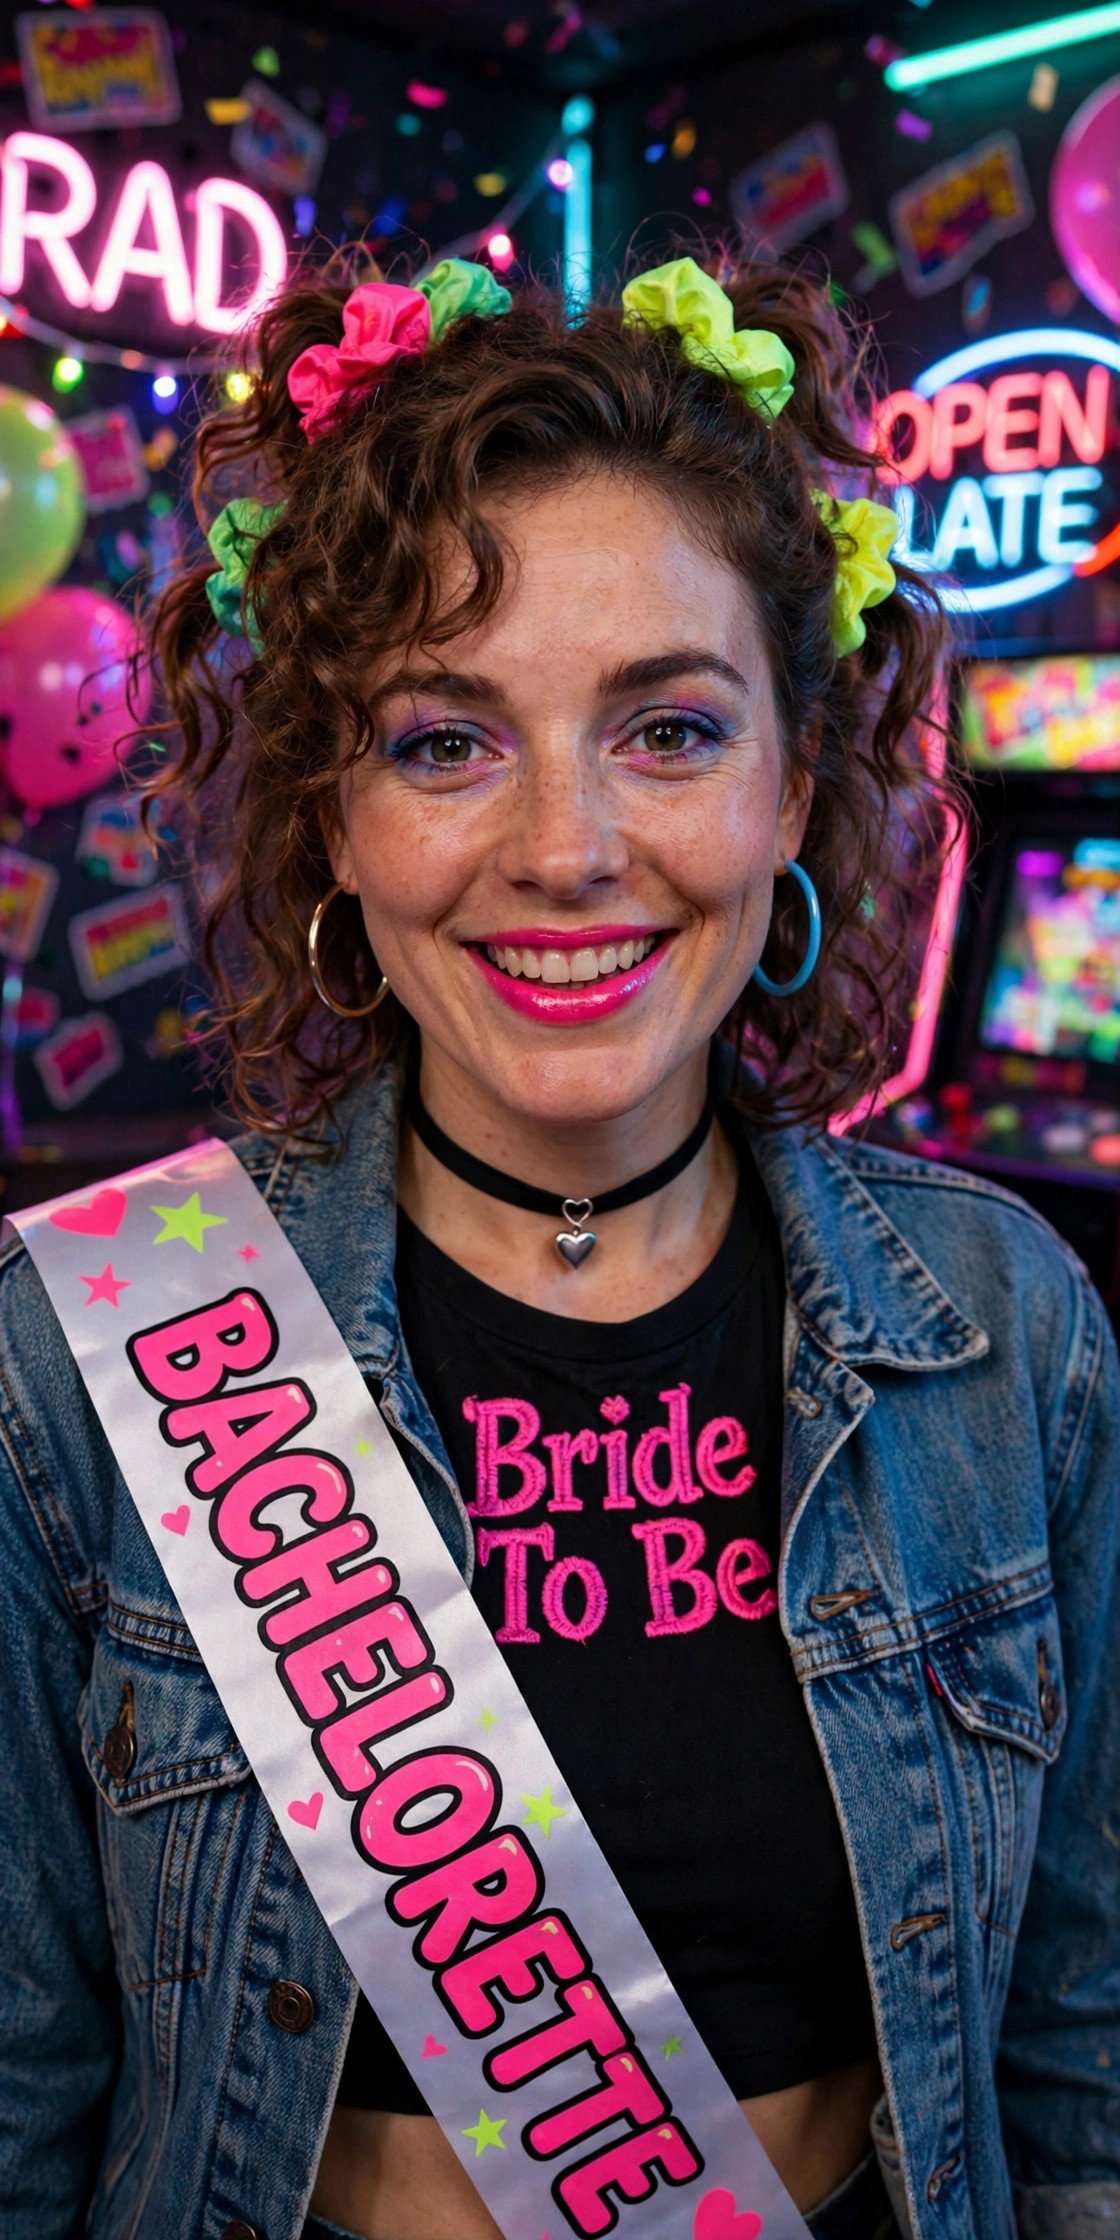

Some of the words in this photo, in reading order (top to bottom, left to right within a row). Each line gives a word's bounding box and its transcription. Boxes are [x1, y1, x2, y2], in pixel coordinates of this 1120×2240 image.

[0, 131, 287, 334] RAD
[869, 364, 1110, 485] OPEN
[891, 466, 1102, 571] LATE
[462, 1382, 757, 1517] Bride
[475, 1521, 608, 1644] To
[631, 1517, 777, 1637] Be
[125, 1286, 705, 2240] BACHELORETTE
